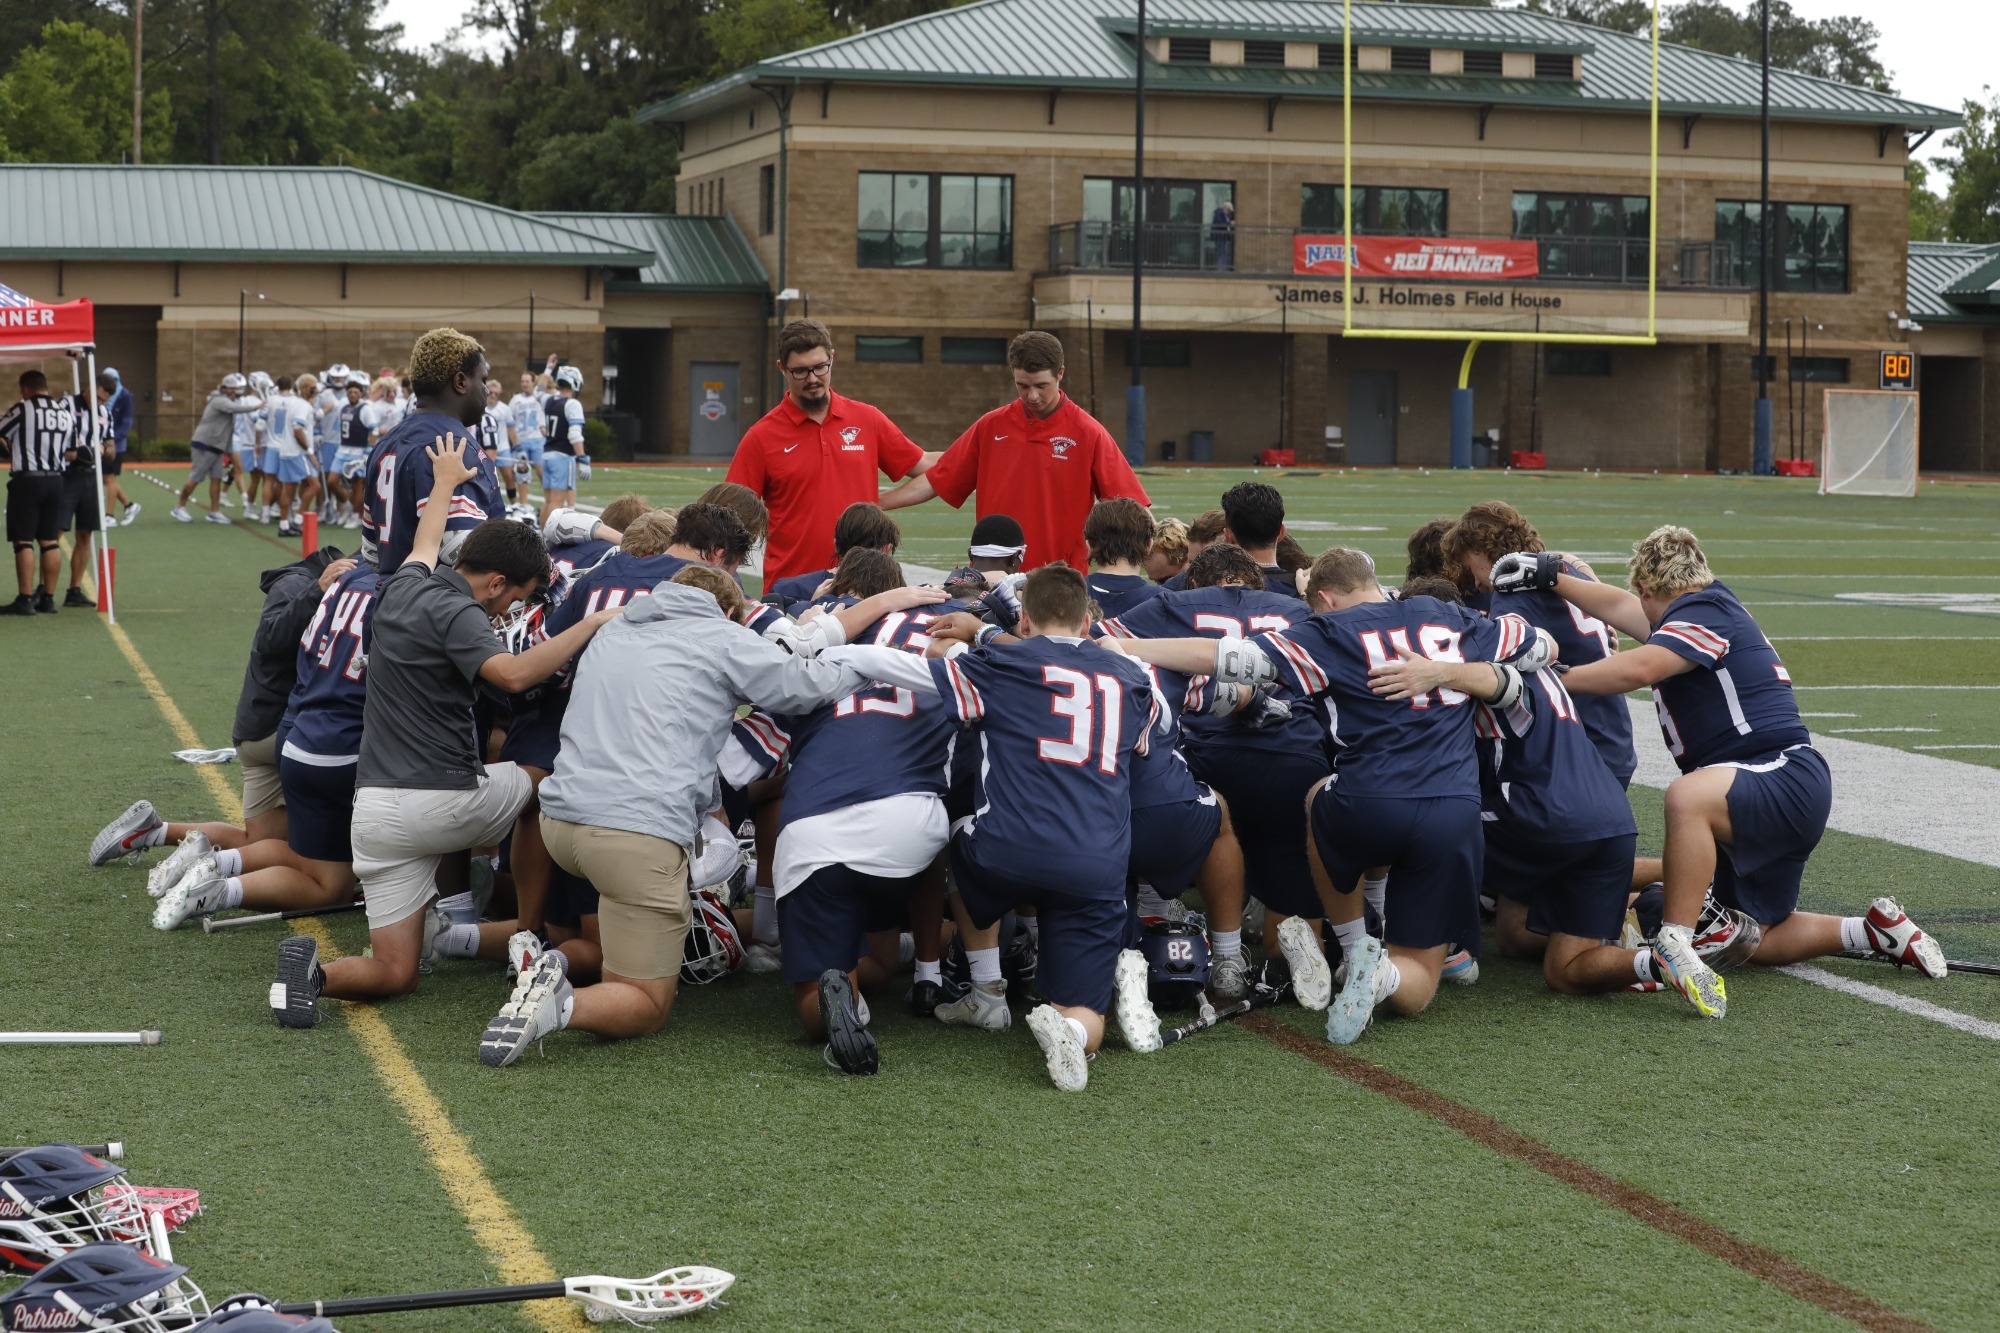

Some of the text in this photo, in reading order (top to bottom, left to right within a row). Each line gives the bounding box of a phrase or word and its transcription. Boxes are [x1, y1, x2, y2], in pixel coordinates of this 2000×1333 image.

[1305, 244, 1359, 269] NAIA
[1392, 253, 1505, 273] RED BANNER
[1276, 285, 1562, 308] James J. Holmes Field House
[1885, 355, 1910, 378] 80
[36, 409, 69, 431] 166
[376, 453, 397, 544] 9
[1037, 665, 1124, 776] 31
[13, 1303, 80, 1330] Patriots
